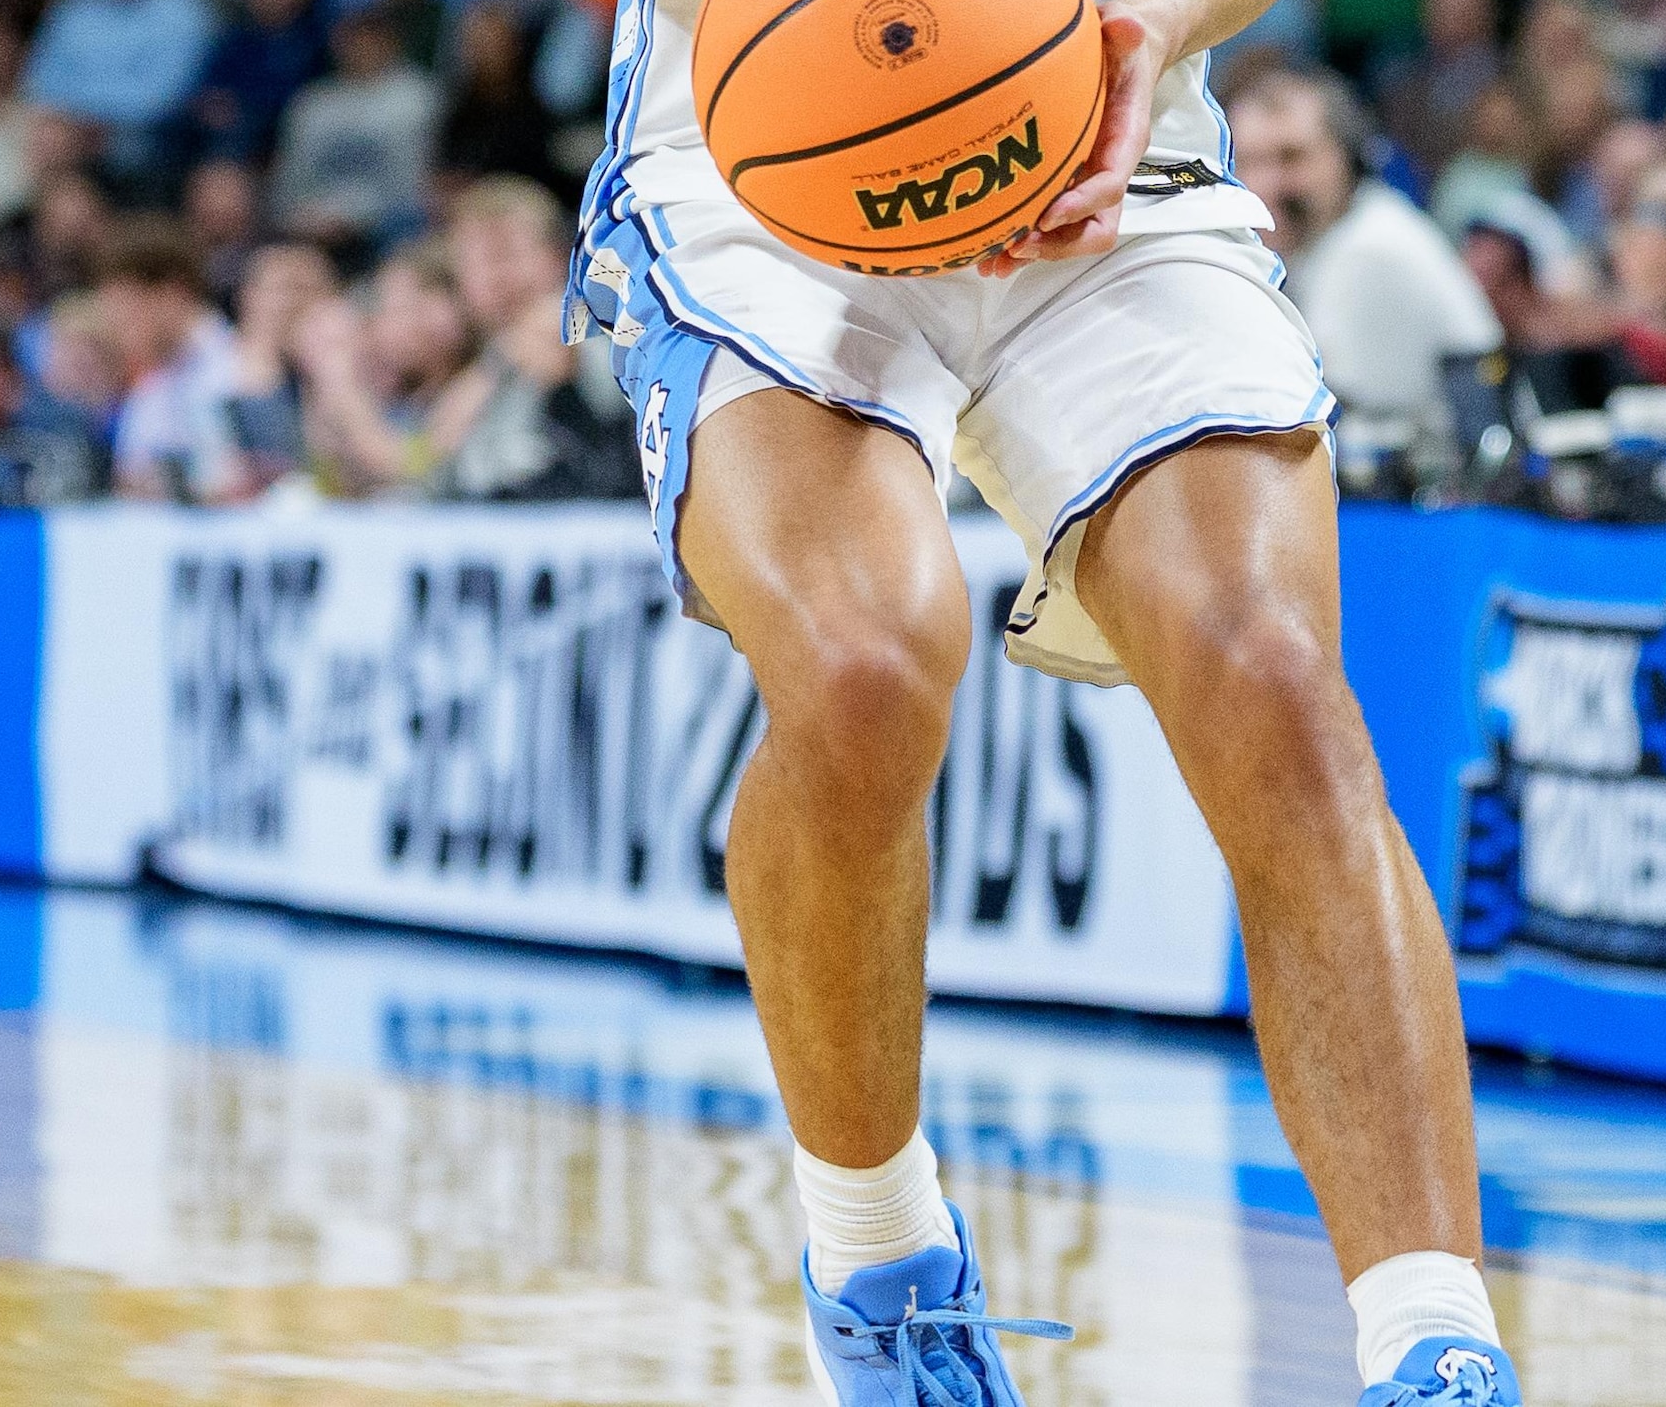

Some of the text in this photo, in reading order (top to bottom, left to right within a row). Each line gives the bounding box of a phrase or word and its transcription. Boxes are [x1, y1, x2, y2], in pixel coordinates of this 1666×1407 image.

[851, 100, 1034, 183] OFFICIAL GAME BALL
[854, 115, 1044, 232] NCAA
